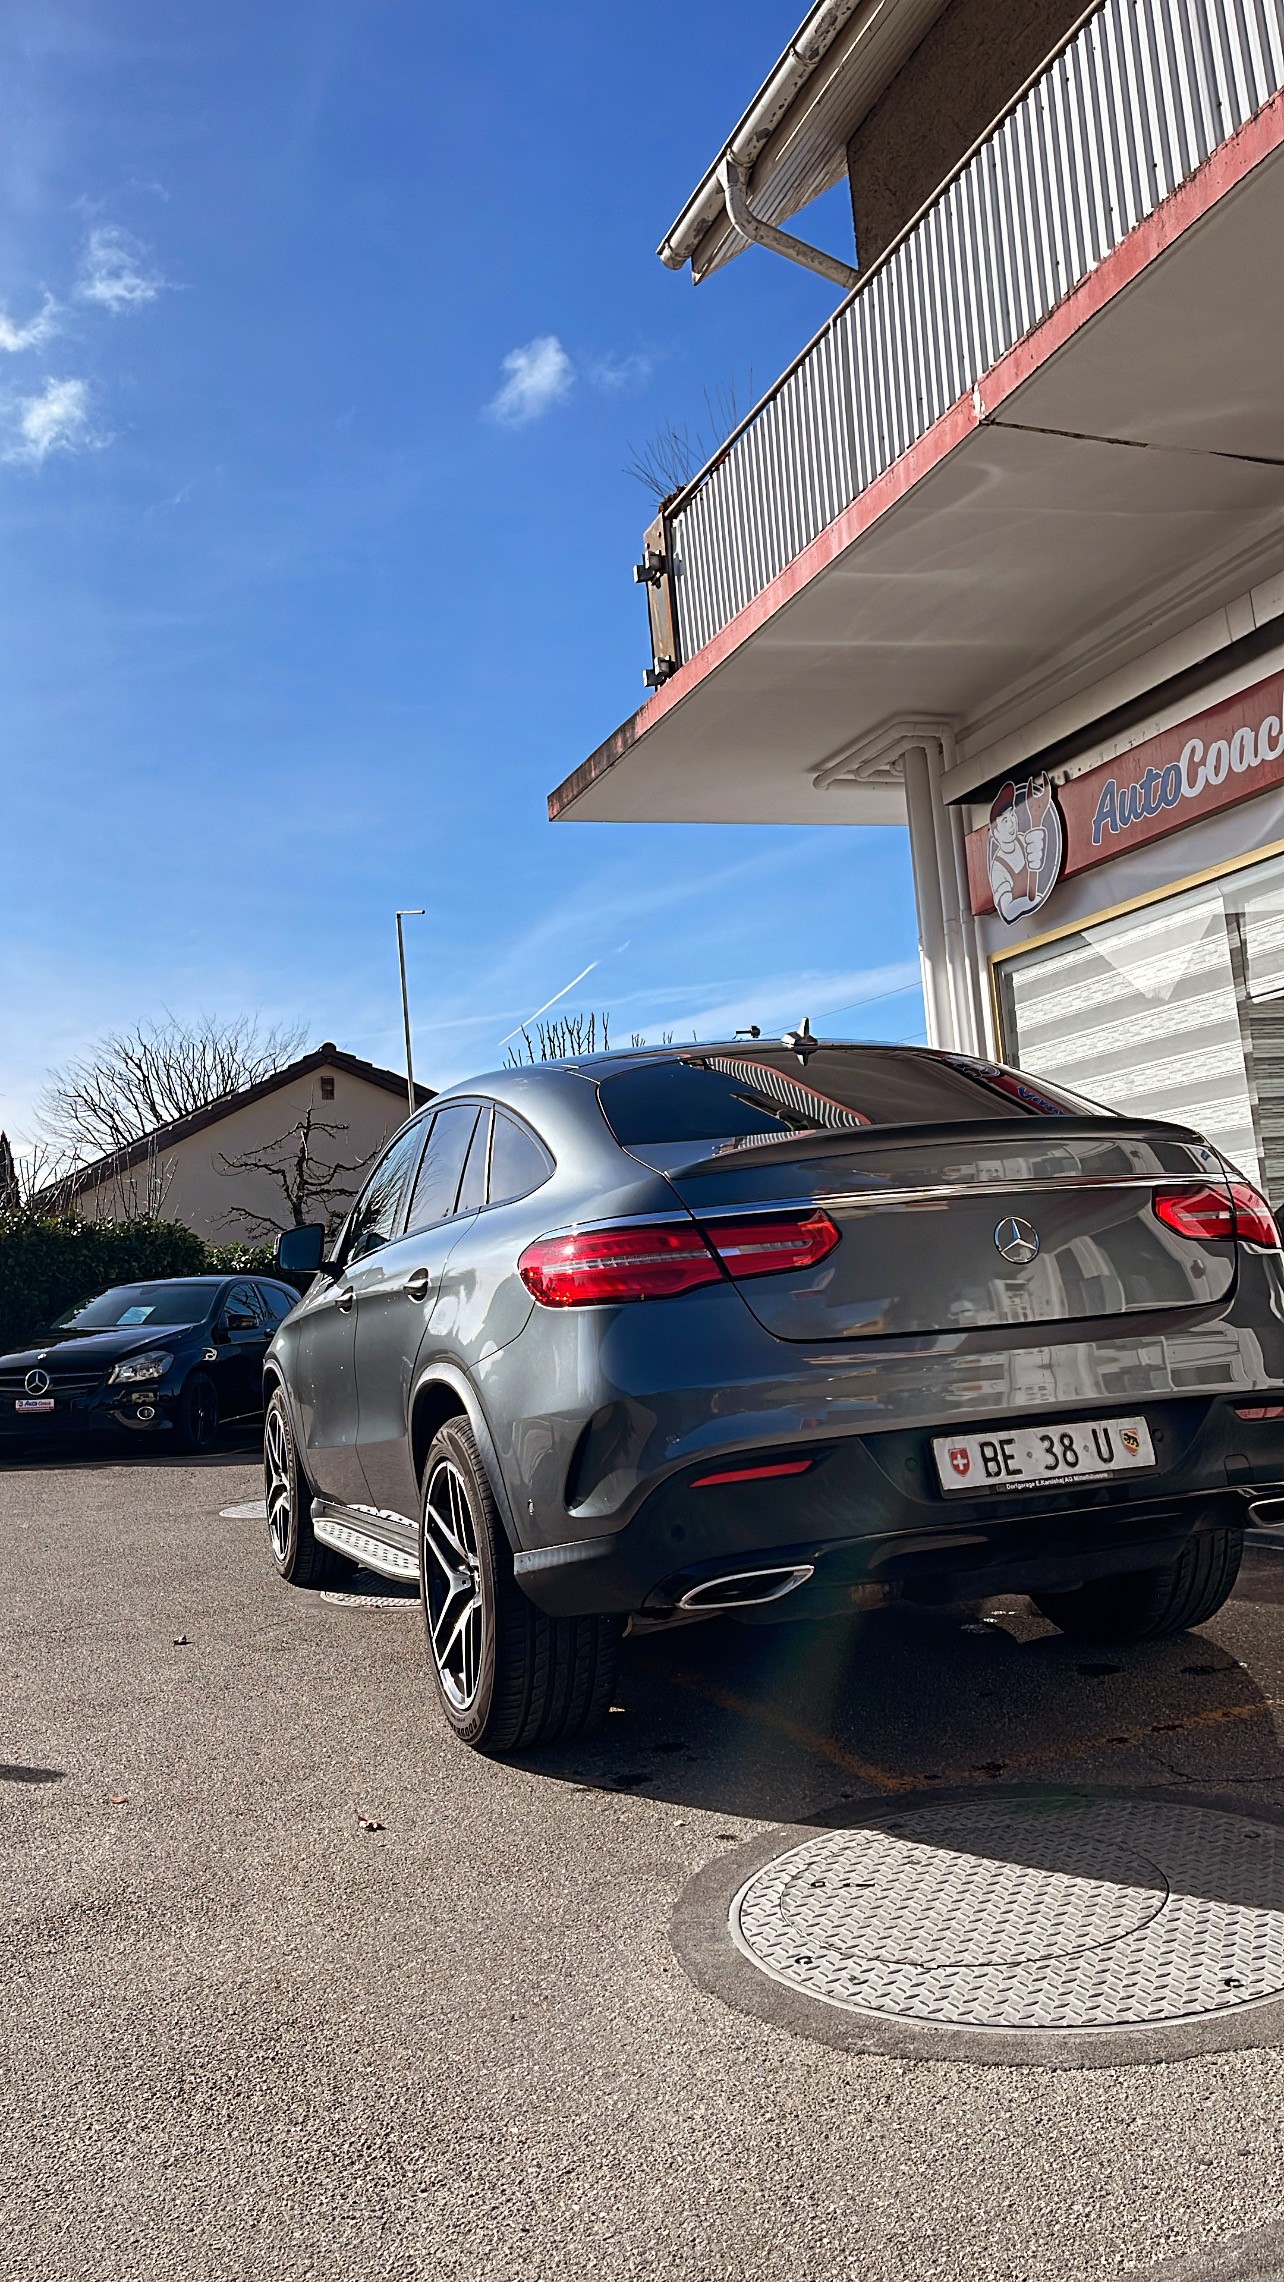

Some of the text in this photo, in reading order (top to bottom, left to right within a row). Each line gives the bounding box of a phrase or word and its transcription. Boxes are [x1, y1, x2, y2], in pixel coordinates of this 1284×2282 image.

[1091, 690, 1284, 845] AutoCoac
[979, 1428, 1115, 1478] BE 38 U
[1006, 1482, 1035, 1490] Dorfgarage
